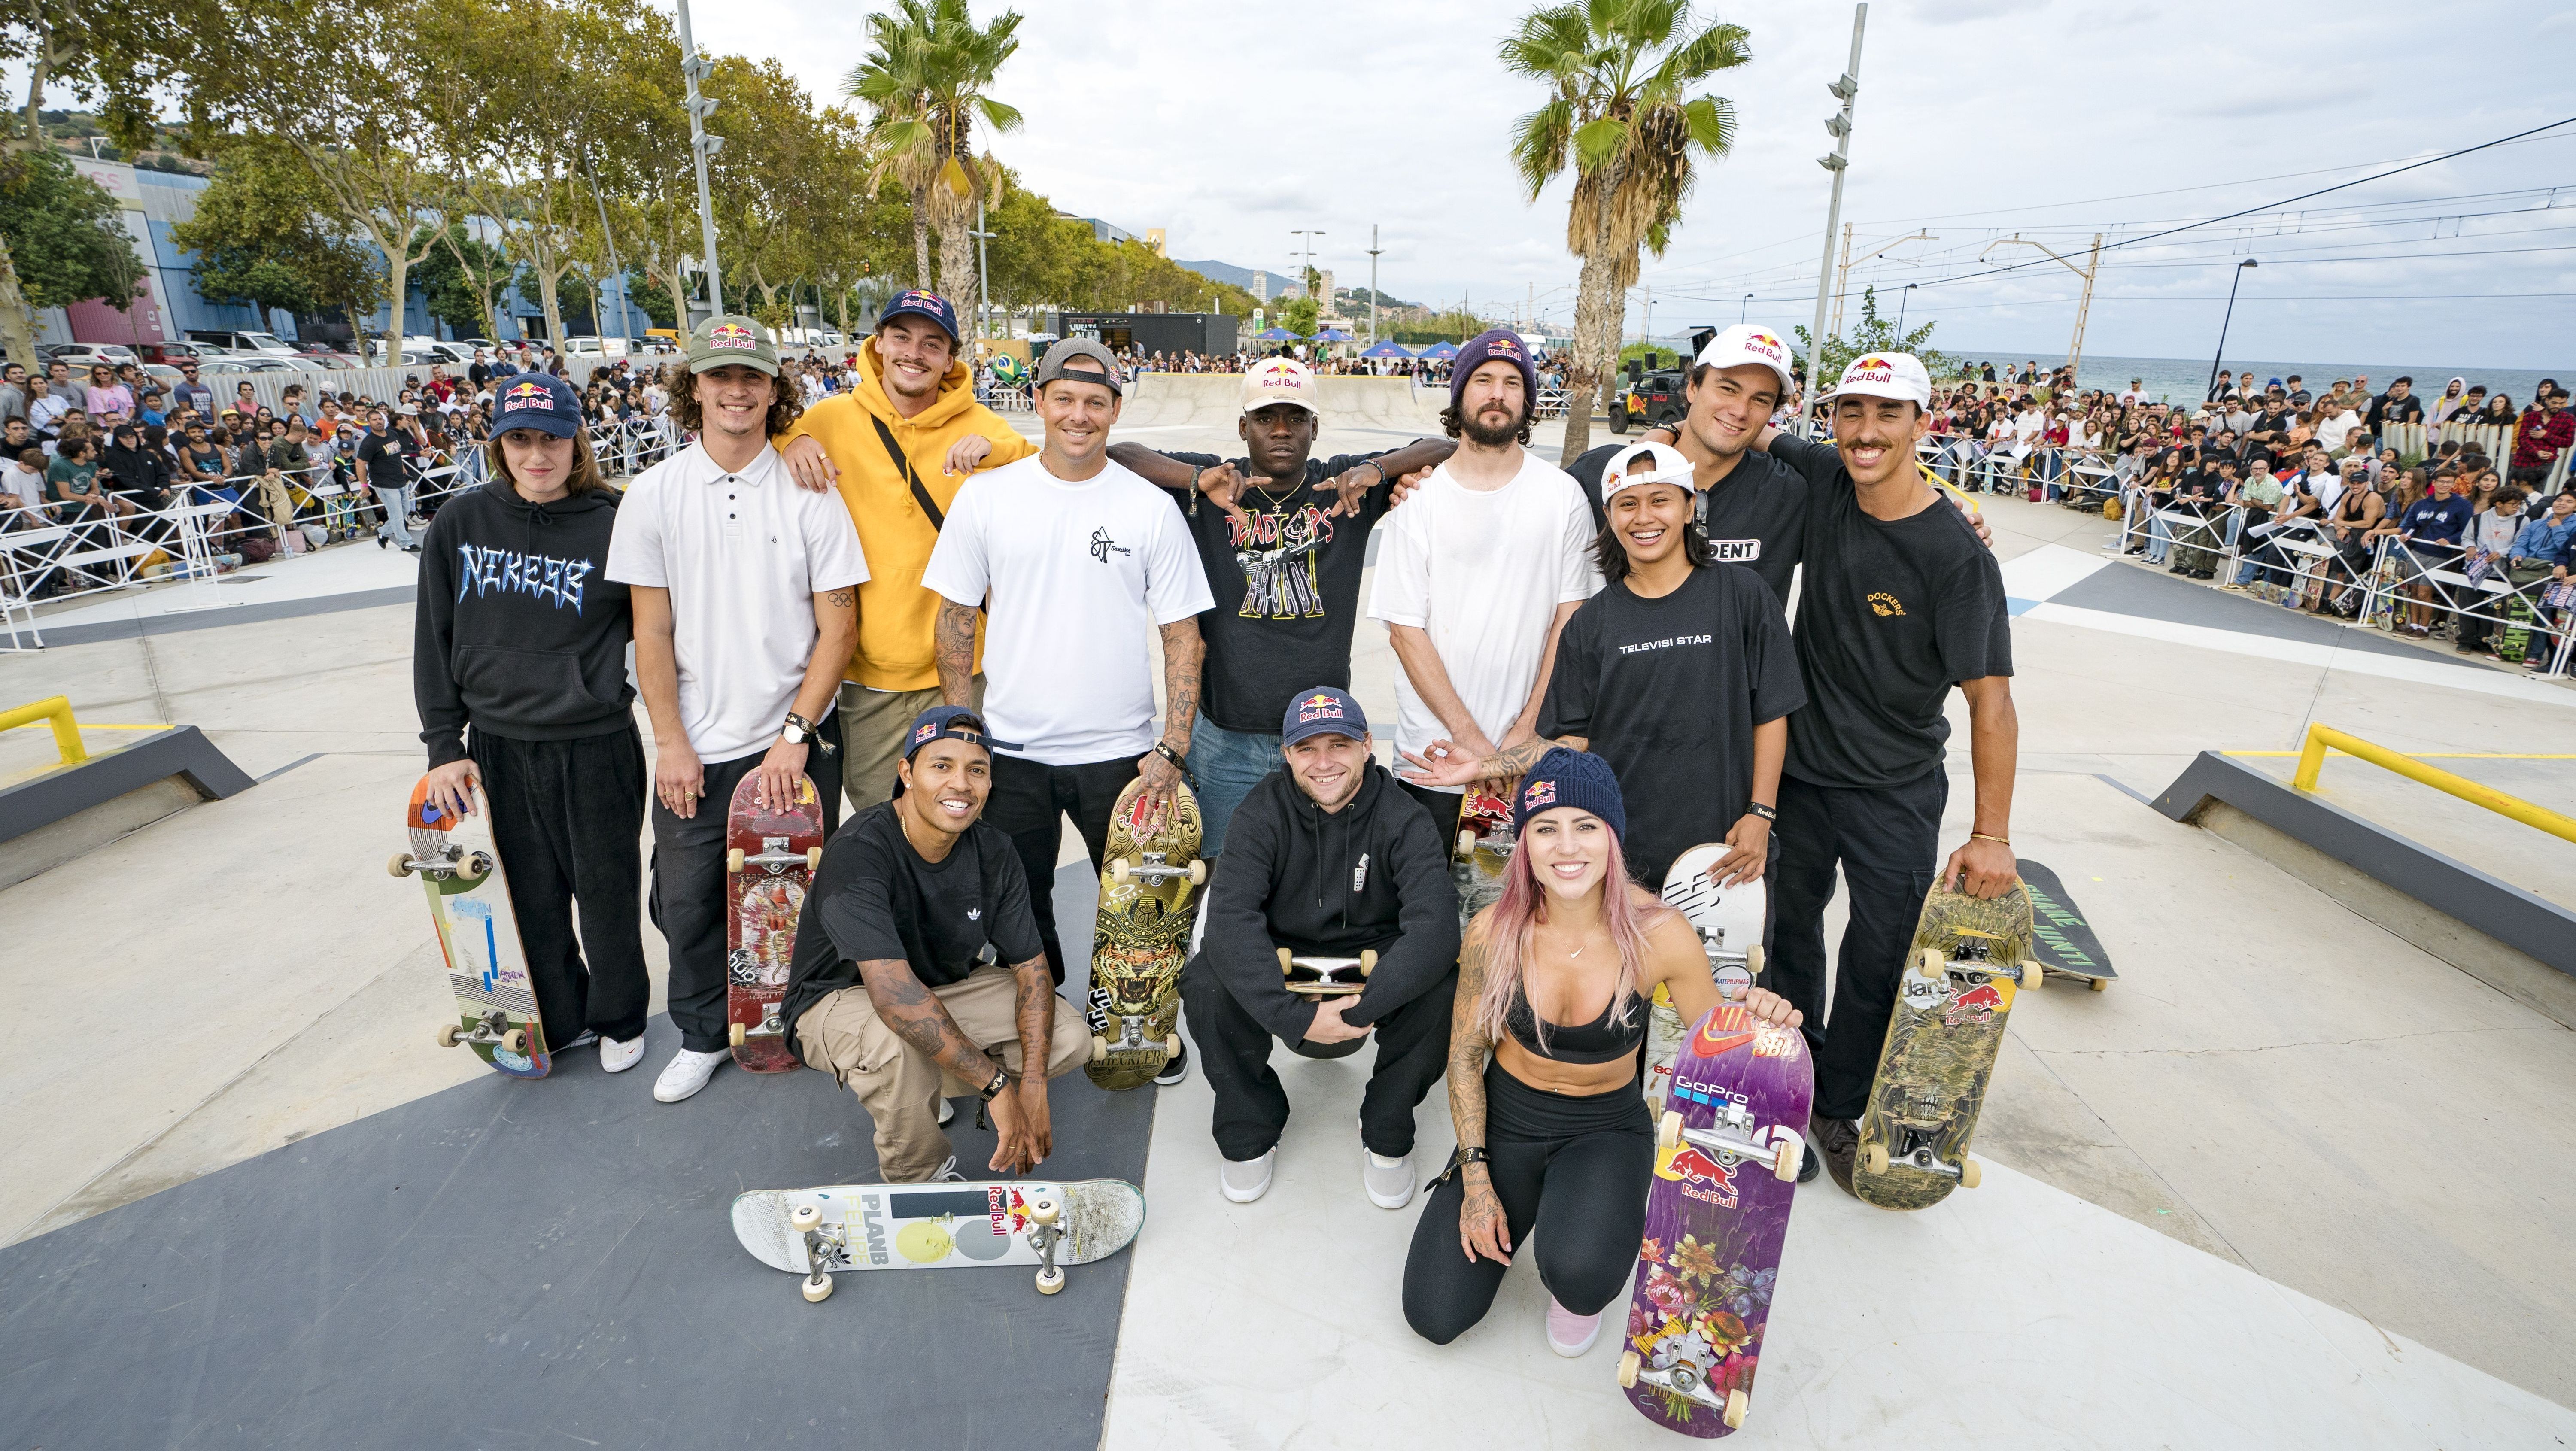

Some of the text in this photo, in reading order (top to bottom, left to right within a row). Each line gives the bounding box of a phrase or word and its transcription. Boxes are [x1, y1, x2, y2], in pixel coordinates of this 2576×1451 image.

[924, 301, 942, 316] Bull
[711, 337, 755, 350] Red Bull
[1744, 342, 1782, 364] Red Bull
[1507, 349, 1521, 361] Bull
[1263, 377, 1301, 389] Red Bull
[1845, 372, 1891, 385] Red Bull
[506, 398, 553, 412] Red Bull
[1867, 592, 1903, 616] DOCKERS
[1619, 634, 1712, 654] TELEVISI STAR
[1300, 708, 1343, 723] Red Bull
[916, 730, 936, 744] Red Bull
[1463, 799, 1474, 817] Bull
[1525, 792, 1555, 811] Red Bull
[1758, 807, 1768, 816] Red
[1136, 825, 1154, 847] Red
[1105, 888, 1144, 907] OAKLEY
[729, 952, 756, 983] hub
[1157, 998, 1179, 1020] ethika
[1708, 1007, 1757, 1031] NIK
[1753, 1035, 1787, 1057] SB
[1676, 1075, 1749, 1104] GoPro
[1682, 1183, 1738, 1209] Red Bull
[988, 1186, 1007, 1236] Red Bull
[843, 1195, 871, 1265] FELIPE
